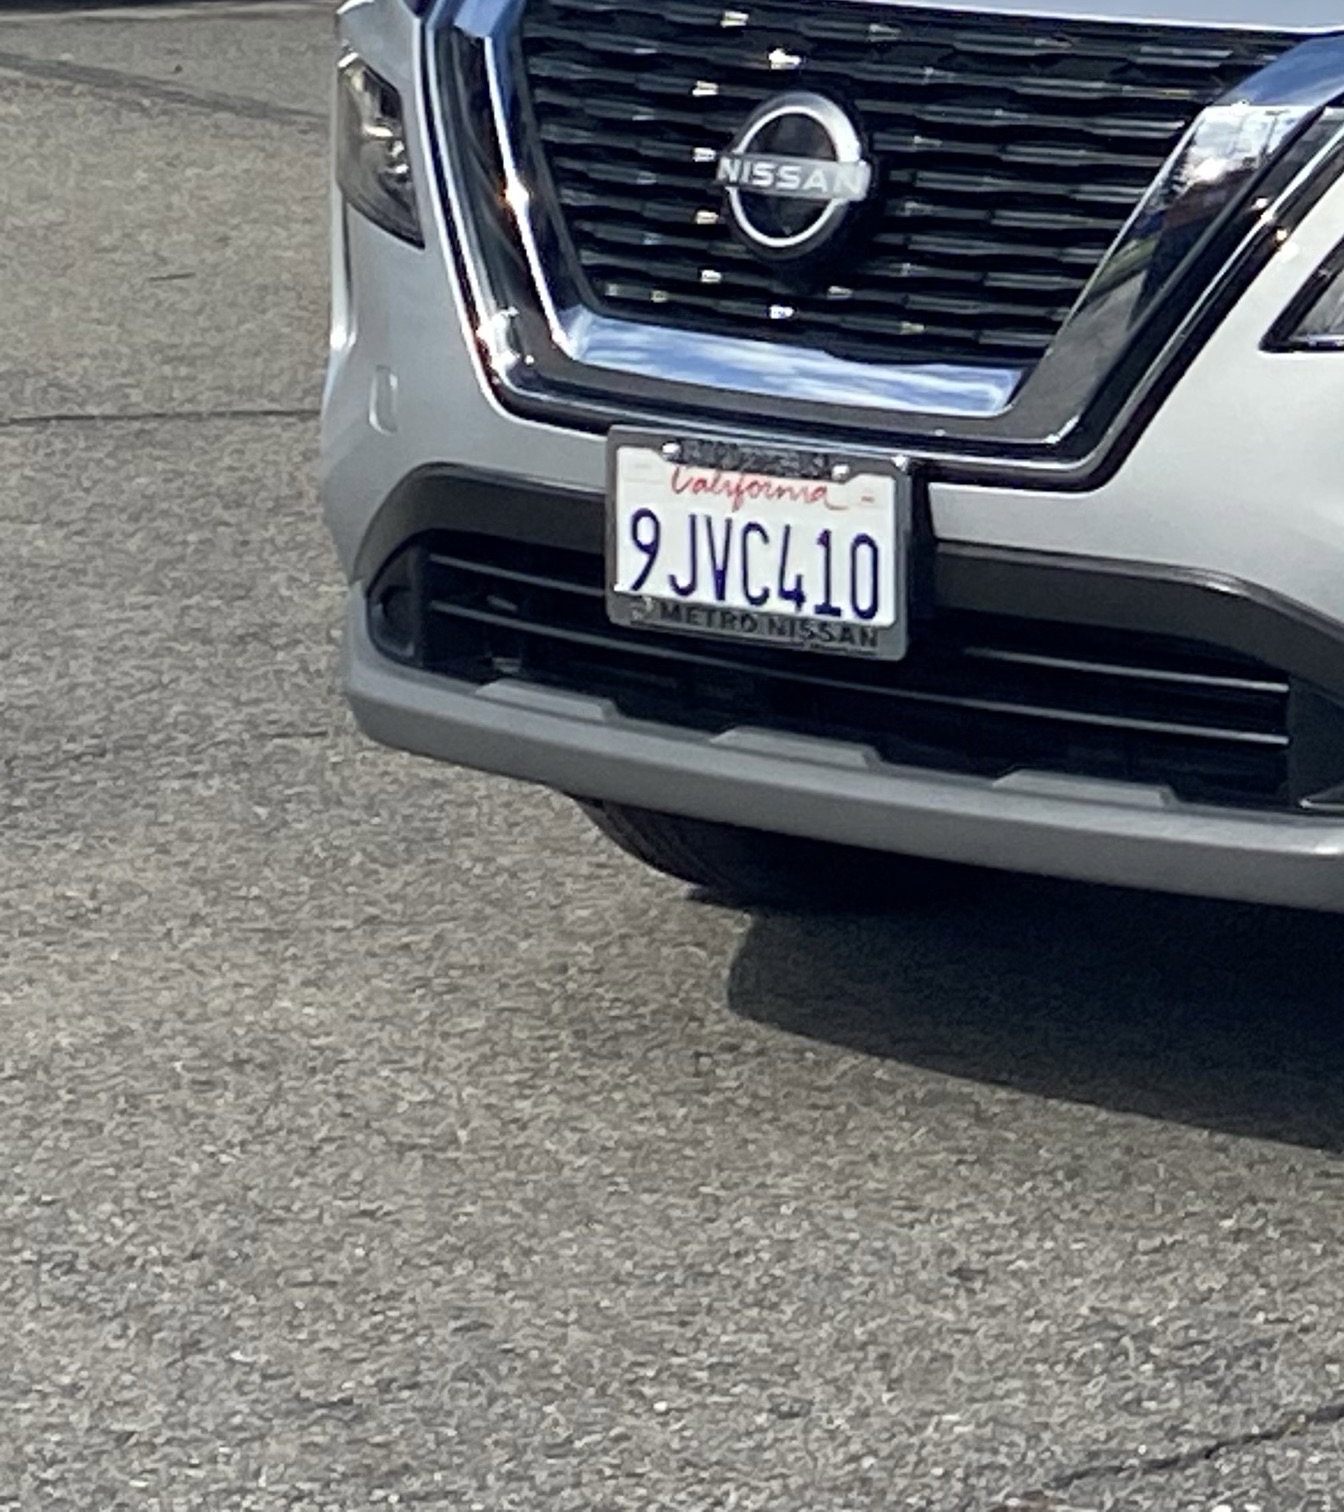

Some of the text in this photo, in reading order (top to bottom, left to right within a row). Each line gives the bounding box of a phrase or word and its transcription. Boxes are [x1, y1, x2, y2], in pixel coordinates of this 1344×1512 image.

[717, 156, 863, 195] NISSAN
[671, 465, 848, 513] California
[630, 507, 879, 621] 9JVC410
[658, 601, 760, 634] METRO
[766, 612, 880, 648] NISSAN
